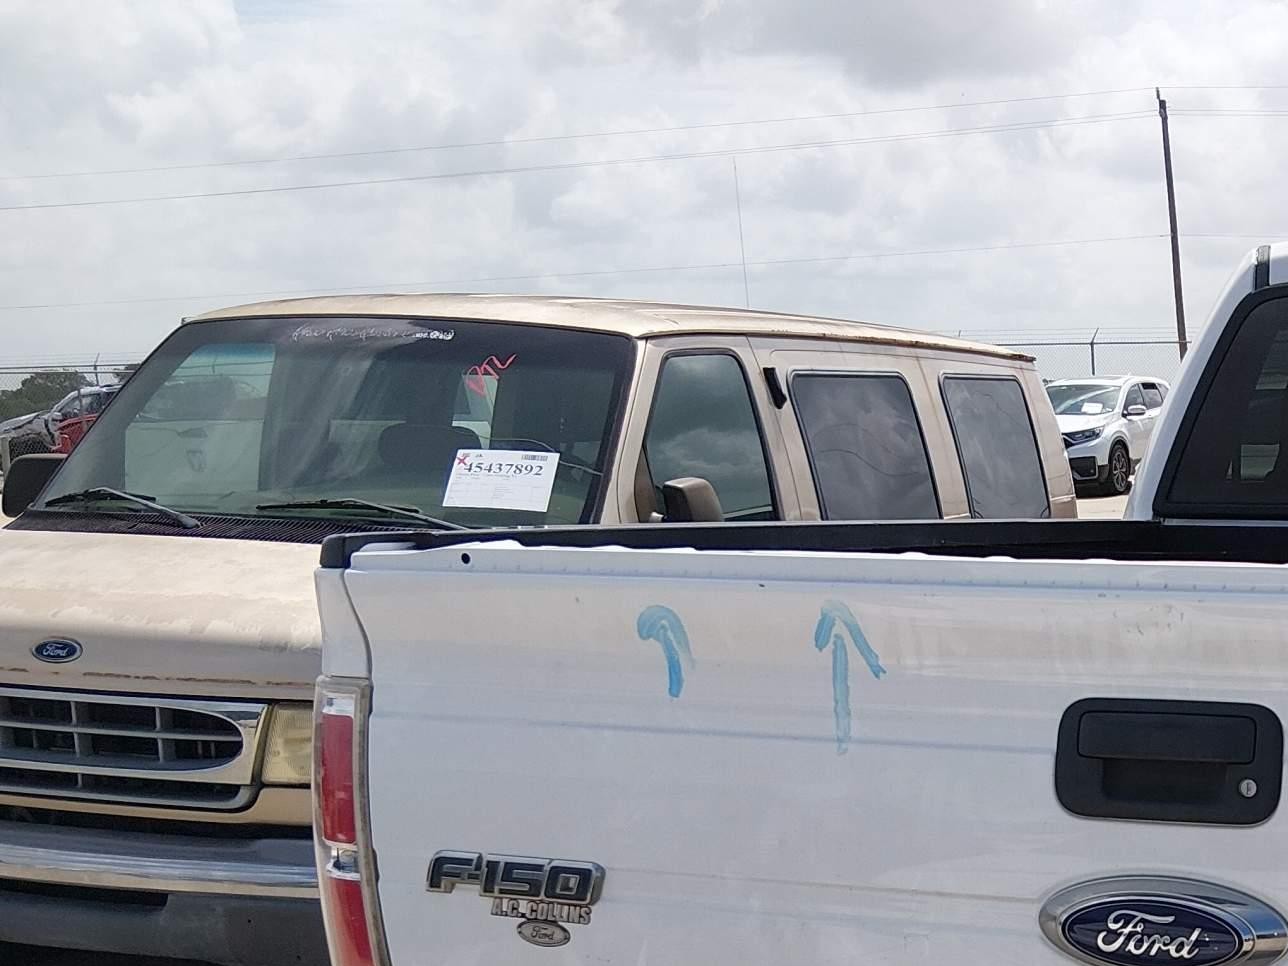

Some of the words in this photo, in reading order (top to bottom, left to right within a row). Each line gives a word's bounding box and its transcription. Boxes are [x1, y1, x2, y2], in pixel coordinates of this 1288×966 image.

[464, 462, 543, 476] 45437892
[43, 643, 69, 656] Ford
[426, 850, 606, 906] F-150
[491, 898, 521, 919] A.C.
[527, 900, 592, 925] COLLINS
[530, 926, 555, 940] Ford
[1097, 909, 1202, 959] Ford
